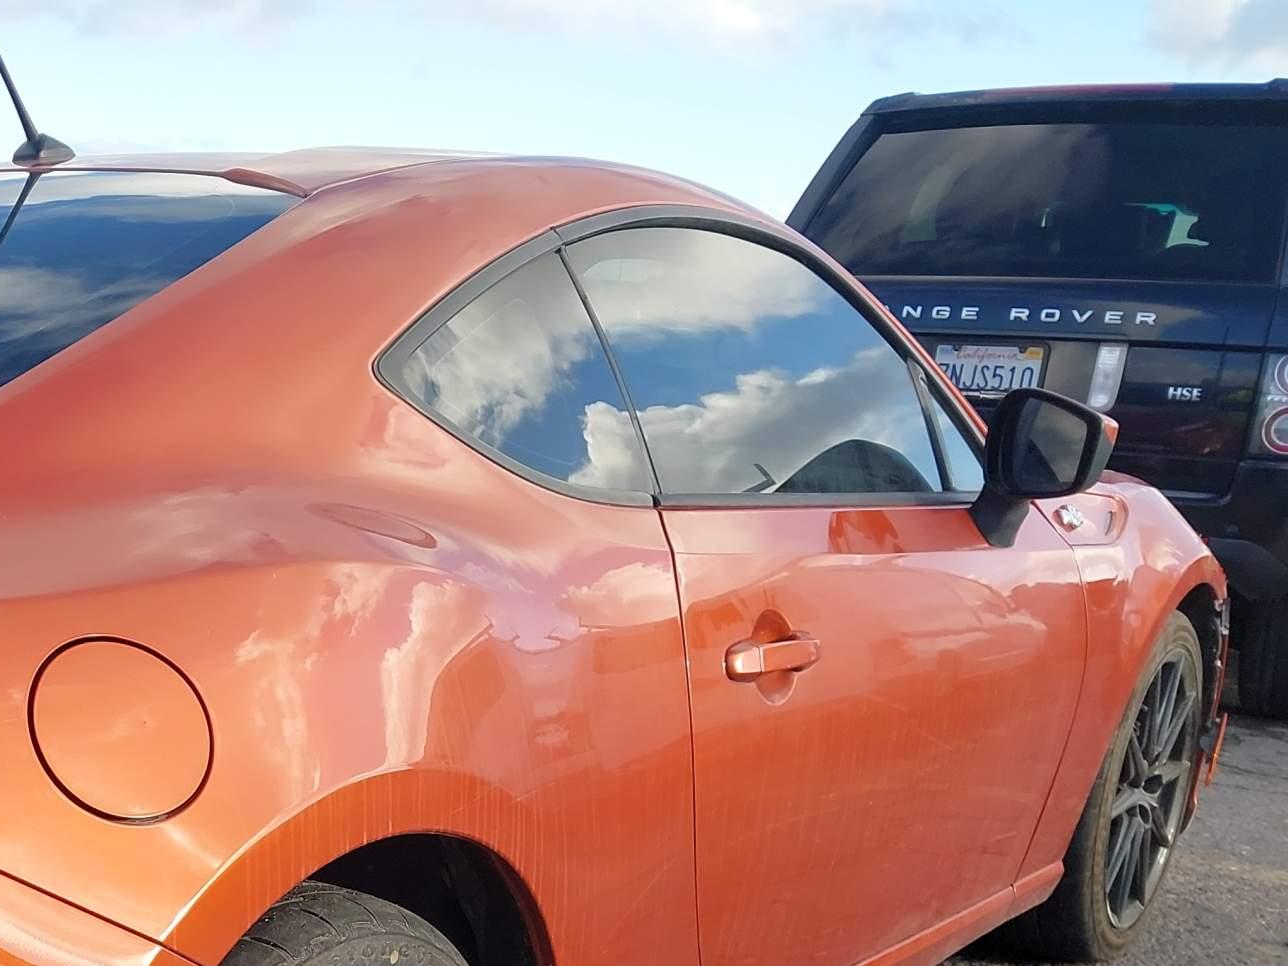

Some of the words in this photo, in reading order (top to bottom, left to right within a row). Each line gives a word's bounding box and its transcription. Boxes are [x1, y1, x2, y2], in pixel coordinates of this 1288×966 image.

[1009, 306, 1158, 326] ROVER
[956, 345, 1018, 363] California
[1167, 386, 1203, 401] HSE
